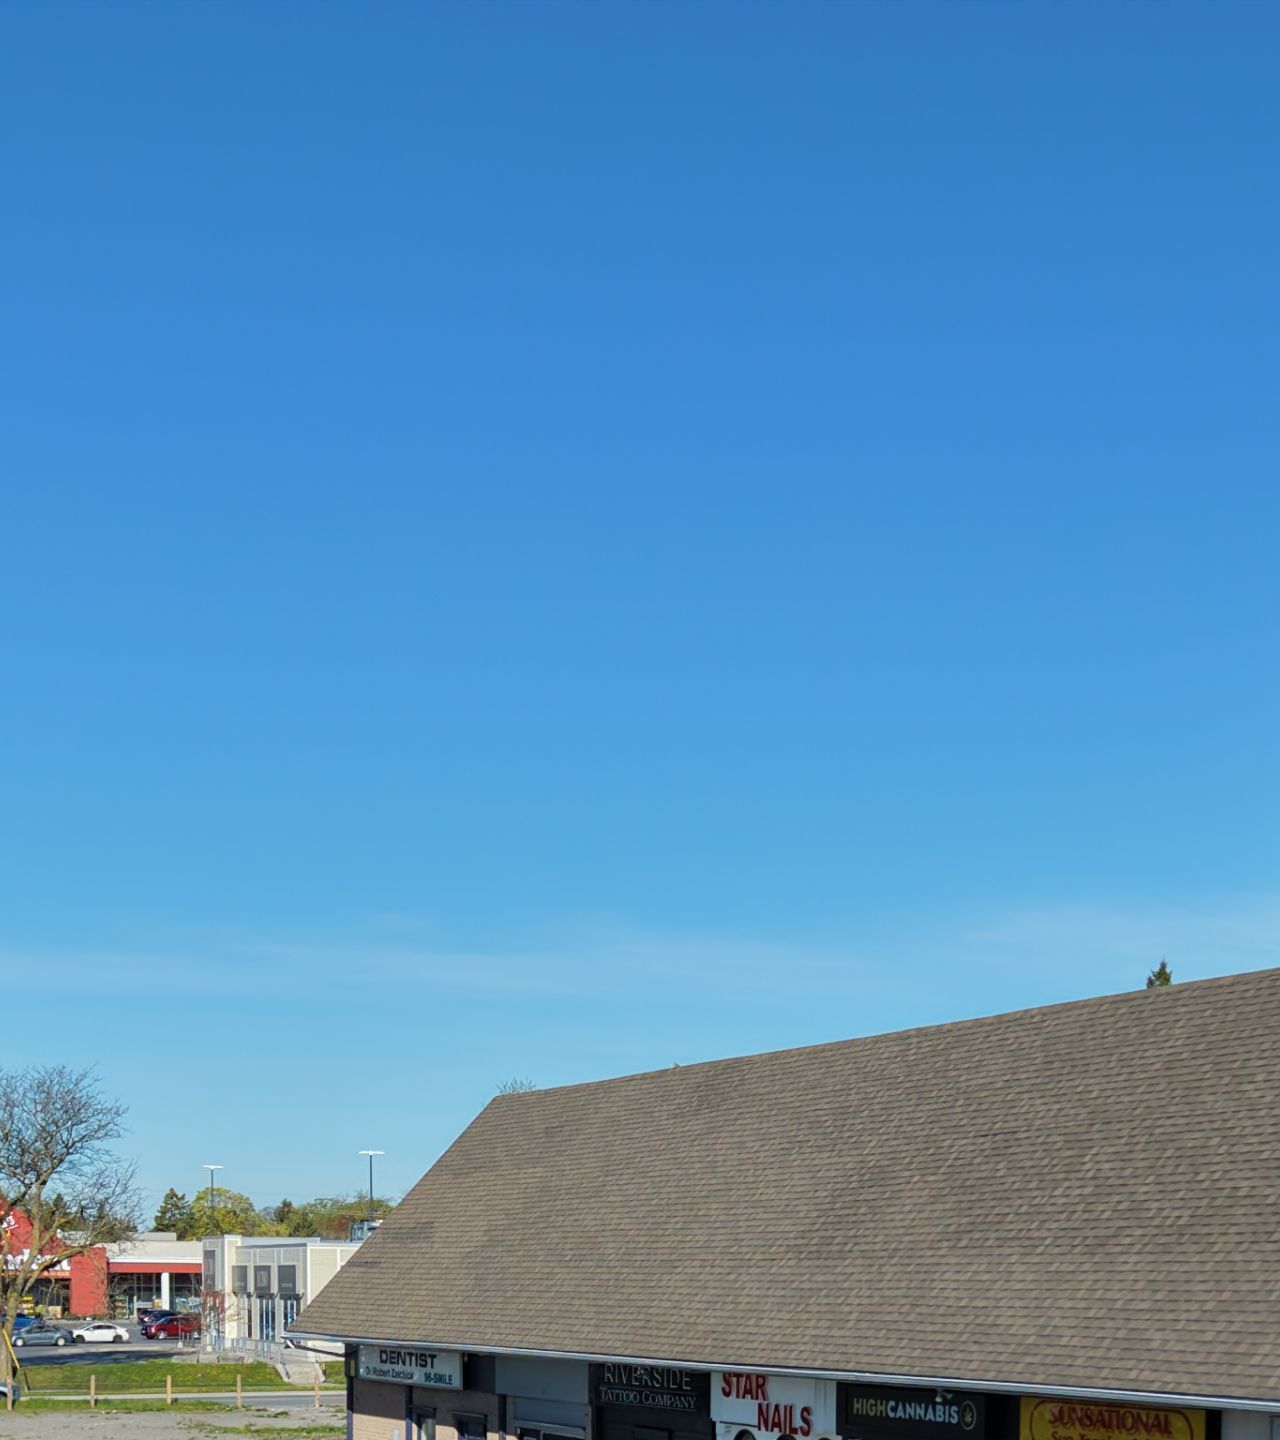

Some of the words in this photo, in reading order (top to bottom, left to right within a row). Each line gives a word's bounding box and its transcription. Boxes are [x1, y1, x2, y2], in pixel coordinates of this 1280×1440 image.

[380, 1350, 437, 1369] DENTIST
[604, 1363, 692, 1390] RIVERSIDE
[721, 1372, 768, 1402] STAR
[757, 1402, 813, 1437] NAILS
[1048, 1404, 1173, 1436] SUNSATIONAL
